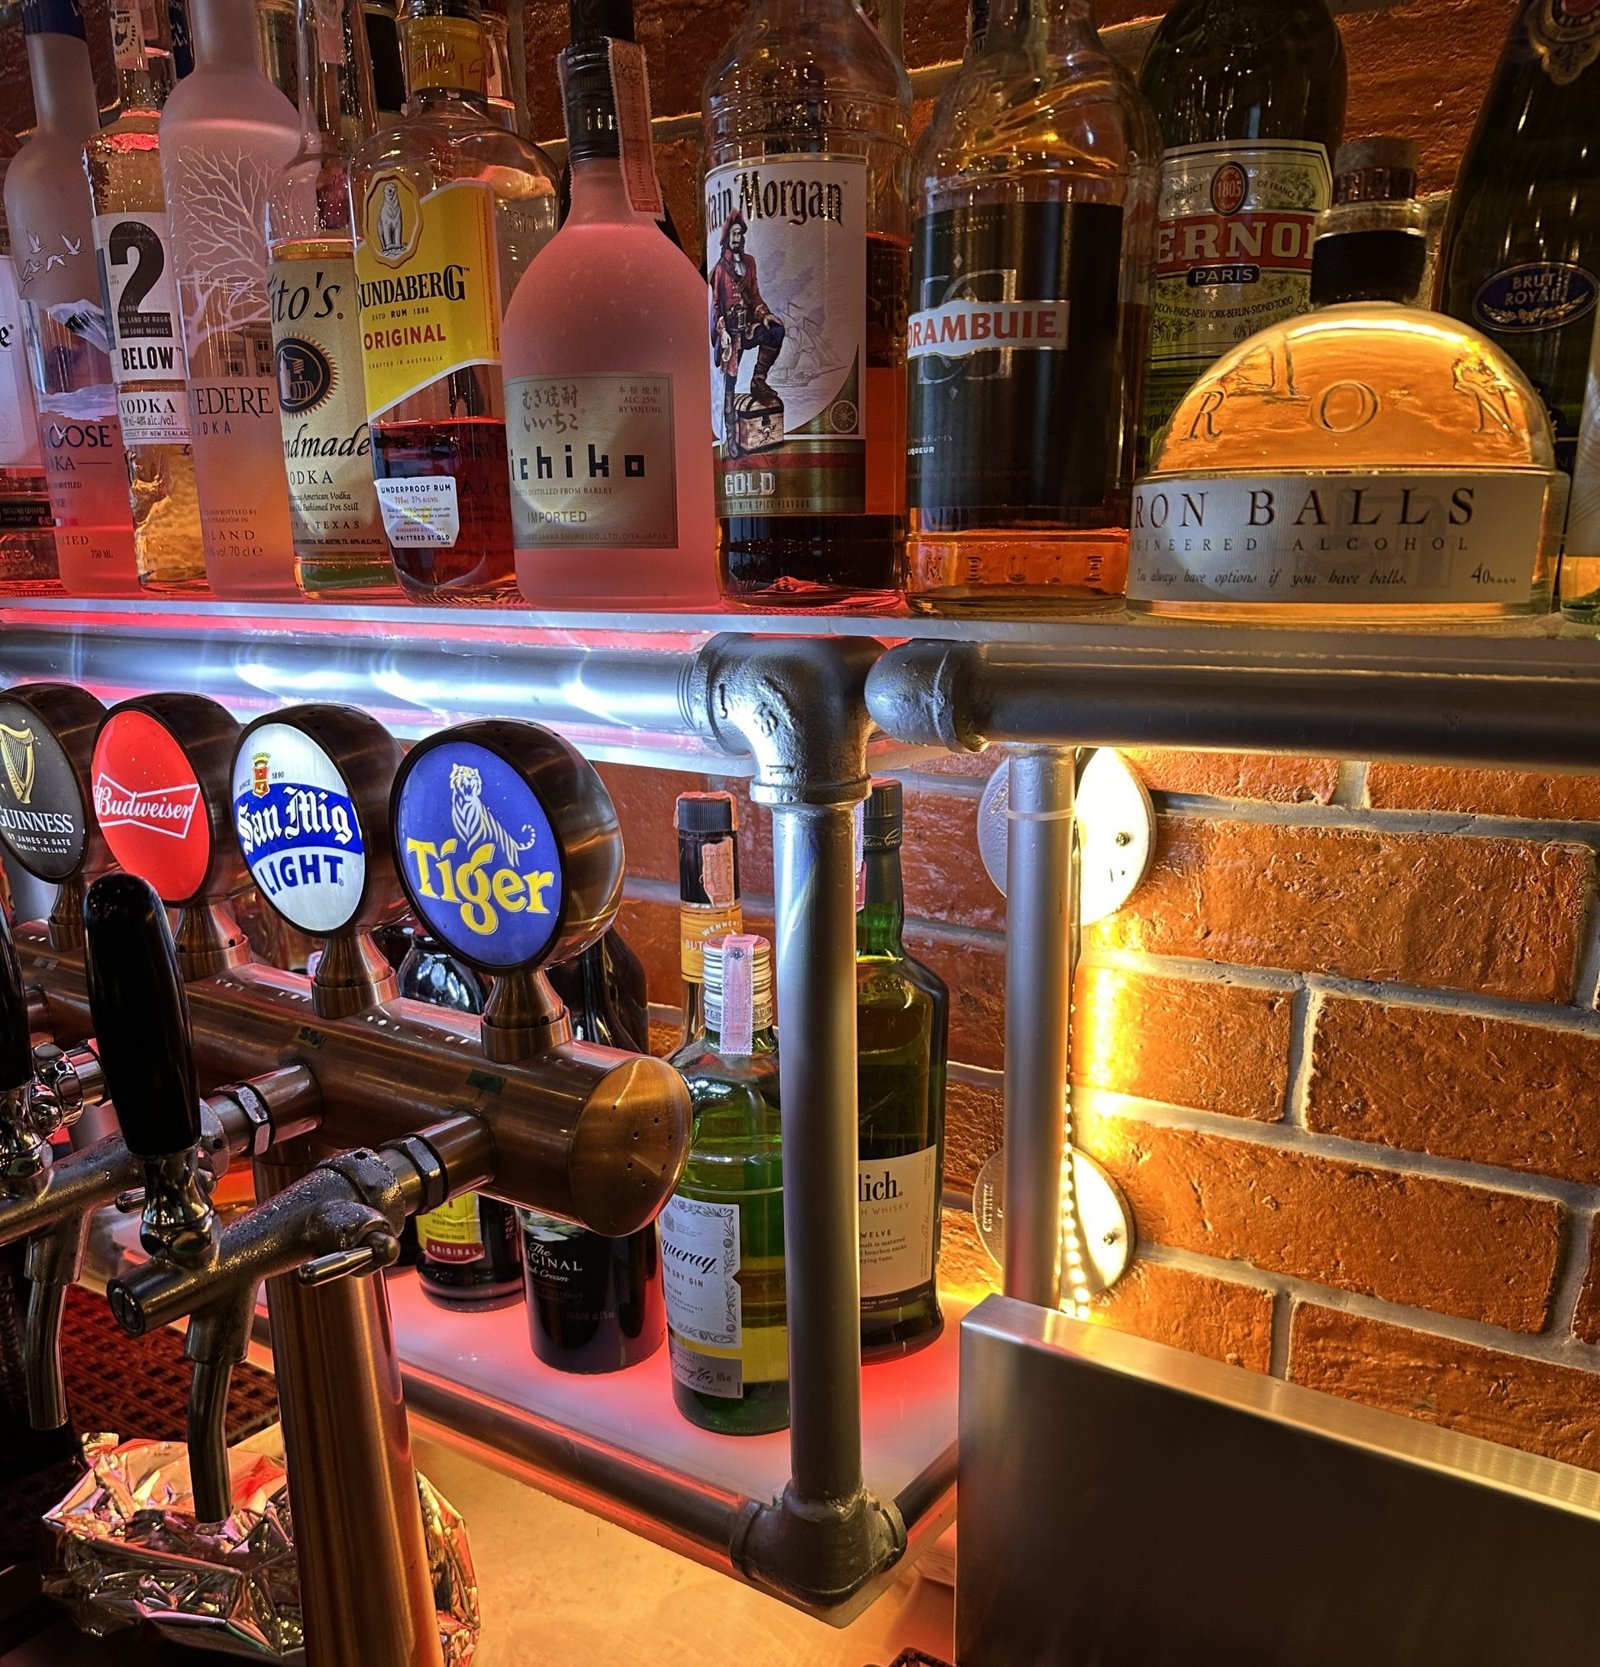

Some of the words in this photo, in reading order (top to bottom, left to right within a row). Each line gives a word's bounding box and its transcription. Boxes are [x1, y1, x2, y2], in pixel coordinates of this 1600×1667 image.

[1216, 181, 1242, 199] 1805
[1257, 180, 1267, 189] OF
[1269, 182, 1297, 200] FRANCE
[733, 170, 844, 229] Morgan
[1157, 221, 1316, 265] ERNO
[109, 221, 173, 338] 2
[1195, 268, 1253, 283] PARIS
[1512, 272, 1556, 290] BRUT
[1505, 284, 1559, 306] ROYAL
[390, 309, 408, 319] RUM
[413, 306, 430, 316] 1888
[363, 323, 447, 351] ORIGINAL
[121, 346, 174, 371] BELOW
[368, 362, 394, 370] CRAFTED
[407, 356, 444, 365] AUSTRALIA
[120, 398, 177, 415] VODKA
[630, 405, 663, 413] VOLUME
[510, 443, 646, 482] ichiko
[380, 484, 431, 494] UNDERPROOF
[433, 483, 452, 492] RUM
[560, 487, 581, 495] FROM
[583, 486, 614, 495] BARLEY
[724, 472, 776, 497] GOLD
[329, 491, 352, 501] Vodka
[329, 502, 342, 512] Pot
[343, 502, 360, 512] Still
[754, 500, 776, 510] SPICE
[1245, 486, 1475, 527] BALLS
[527, 510, 588, 524] IMPORTED
[314, 520, 361, 530] TEXAS
[1292, 536, 1468, 551] ALCOHOL
[1184, 568, 1207, 584] have
[1214, 569, 1258, 587] options
[1268, 569, 1282, 587] if
[1289, 574, 1317, 588] you
[1327, 569, 1361, 585] have
[1369, 569, 1408, 585] balls.
[272, 771, 285, 780] 1890
[94, 784, 195, 820] Budweiser
[237, 802, 282, 856] San
[283, 785, 354, 845] Mig
[17, 834, 49, 845] JAMES'S
[51, 838, 72, 846] GATE
[259, 853, 344, 896] LIGHT
[406, 837, 555, 936] Tiger
[872, 1201, 910, 1216] WHISKY
[882, 1236, 906, 1247] matured
[431, 1244, 477, 1256] ORIGINAL
[529, 1242, 552, 1257] The
[864, 1248, 891, 1256] bourbon
[540, 1269, 570, 1282] Cream
[689, 1277, 704, 1288] GIN
